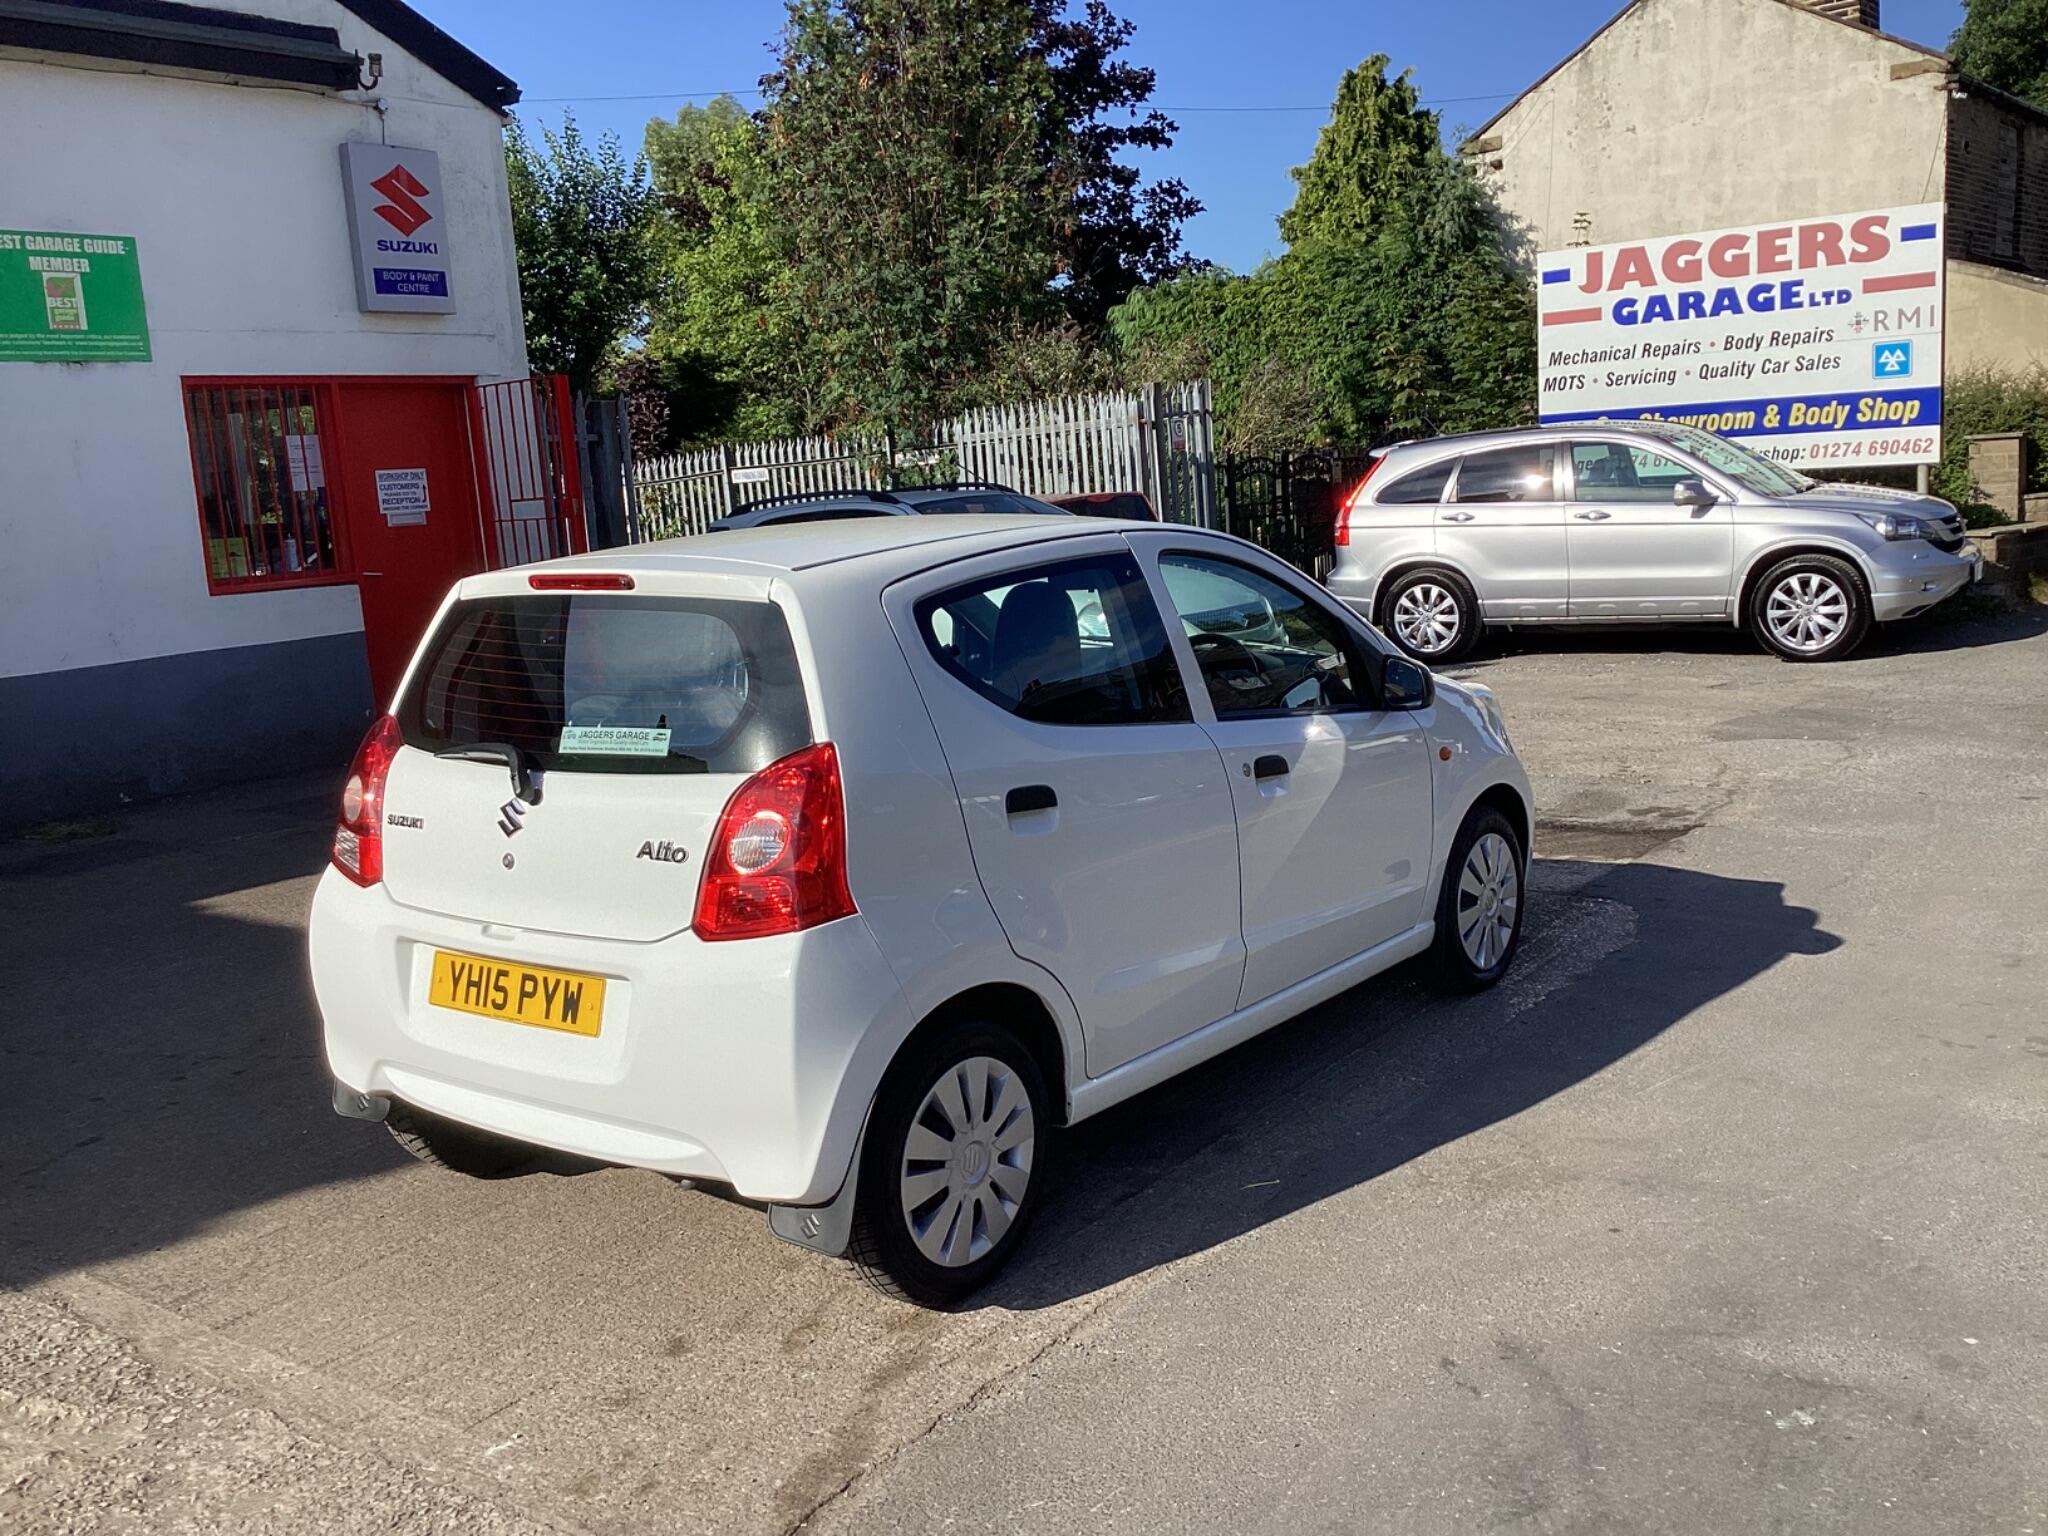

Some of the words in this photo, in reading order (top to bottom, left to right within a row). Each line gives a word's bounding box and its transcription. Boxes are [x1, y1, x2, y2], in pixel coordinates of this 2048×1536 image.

[0, 234, 21, 249] EST
[25, 236, 82, 252] GARAGE
[83, 238, 126, 254] GUIDE
[376, 239, 438, 255] SUZUKI
[28, 256, 90, 272] MEMBER
[1577, 215, 1891, 294] JAGGERS
[383, 271, 407, 281] BODY
[409, 272, 416, 281] &
[417, 272, 440, 282] PAINT
[397, 283, 430, 293] CENTRE
[48, 296, 77, 308] BEST
[1612, 279, 1804, 326] GARAGE
[1808, 289, 1853, 308] LTD
[1873, 304, 1936, 332] RMI
[1548, 343, 1637, 367] Mechanical
[1641, 339, 1702, 361] Repairs
[1723, 332, 1764, 352] Body
[1769, 327, 1835, 348] Repairs
[1543, 374, 1586, 392] MOTS
[1605, 368, 1677, 387] Servicing
[1698, 361, 1756, 380] Quality
[1761, 358, 1790, 375] Car
[1794, 354, 1842, 372] Sales
[1763, 404, 1781, 429] &
[1788, 400, 1850, 429] Body
[1856, 397, 1921, 425] Shop
[1809, 441, 1862, 459] 01274
[1868, 438, 1934, 457] 690462
[380, 482, 420, 491] CUSTOMERS
[382, 497, 420, 505] RECEPTION
[578, 730, 614, 739] JAGGERS
[616, 731, 650, 741] GARAGE
[387, 814, 424, 829] SUZUKI
[636, 839, 689, 865] Alto
[450, 960, 510, 1011] YH15
[516, 972, 584, 1025] PYW
